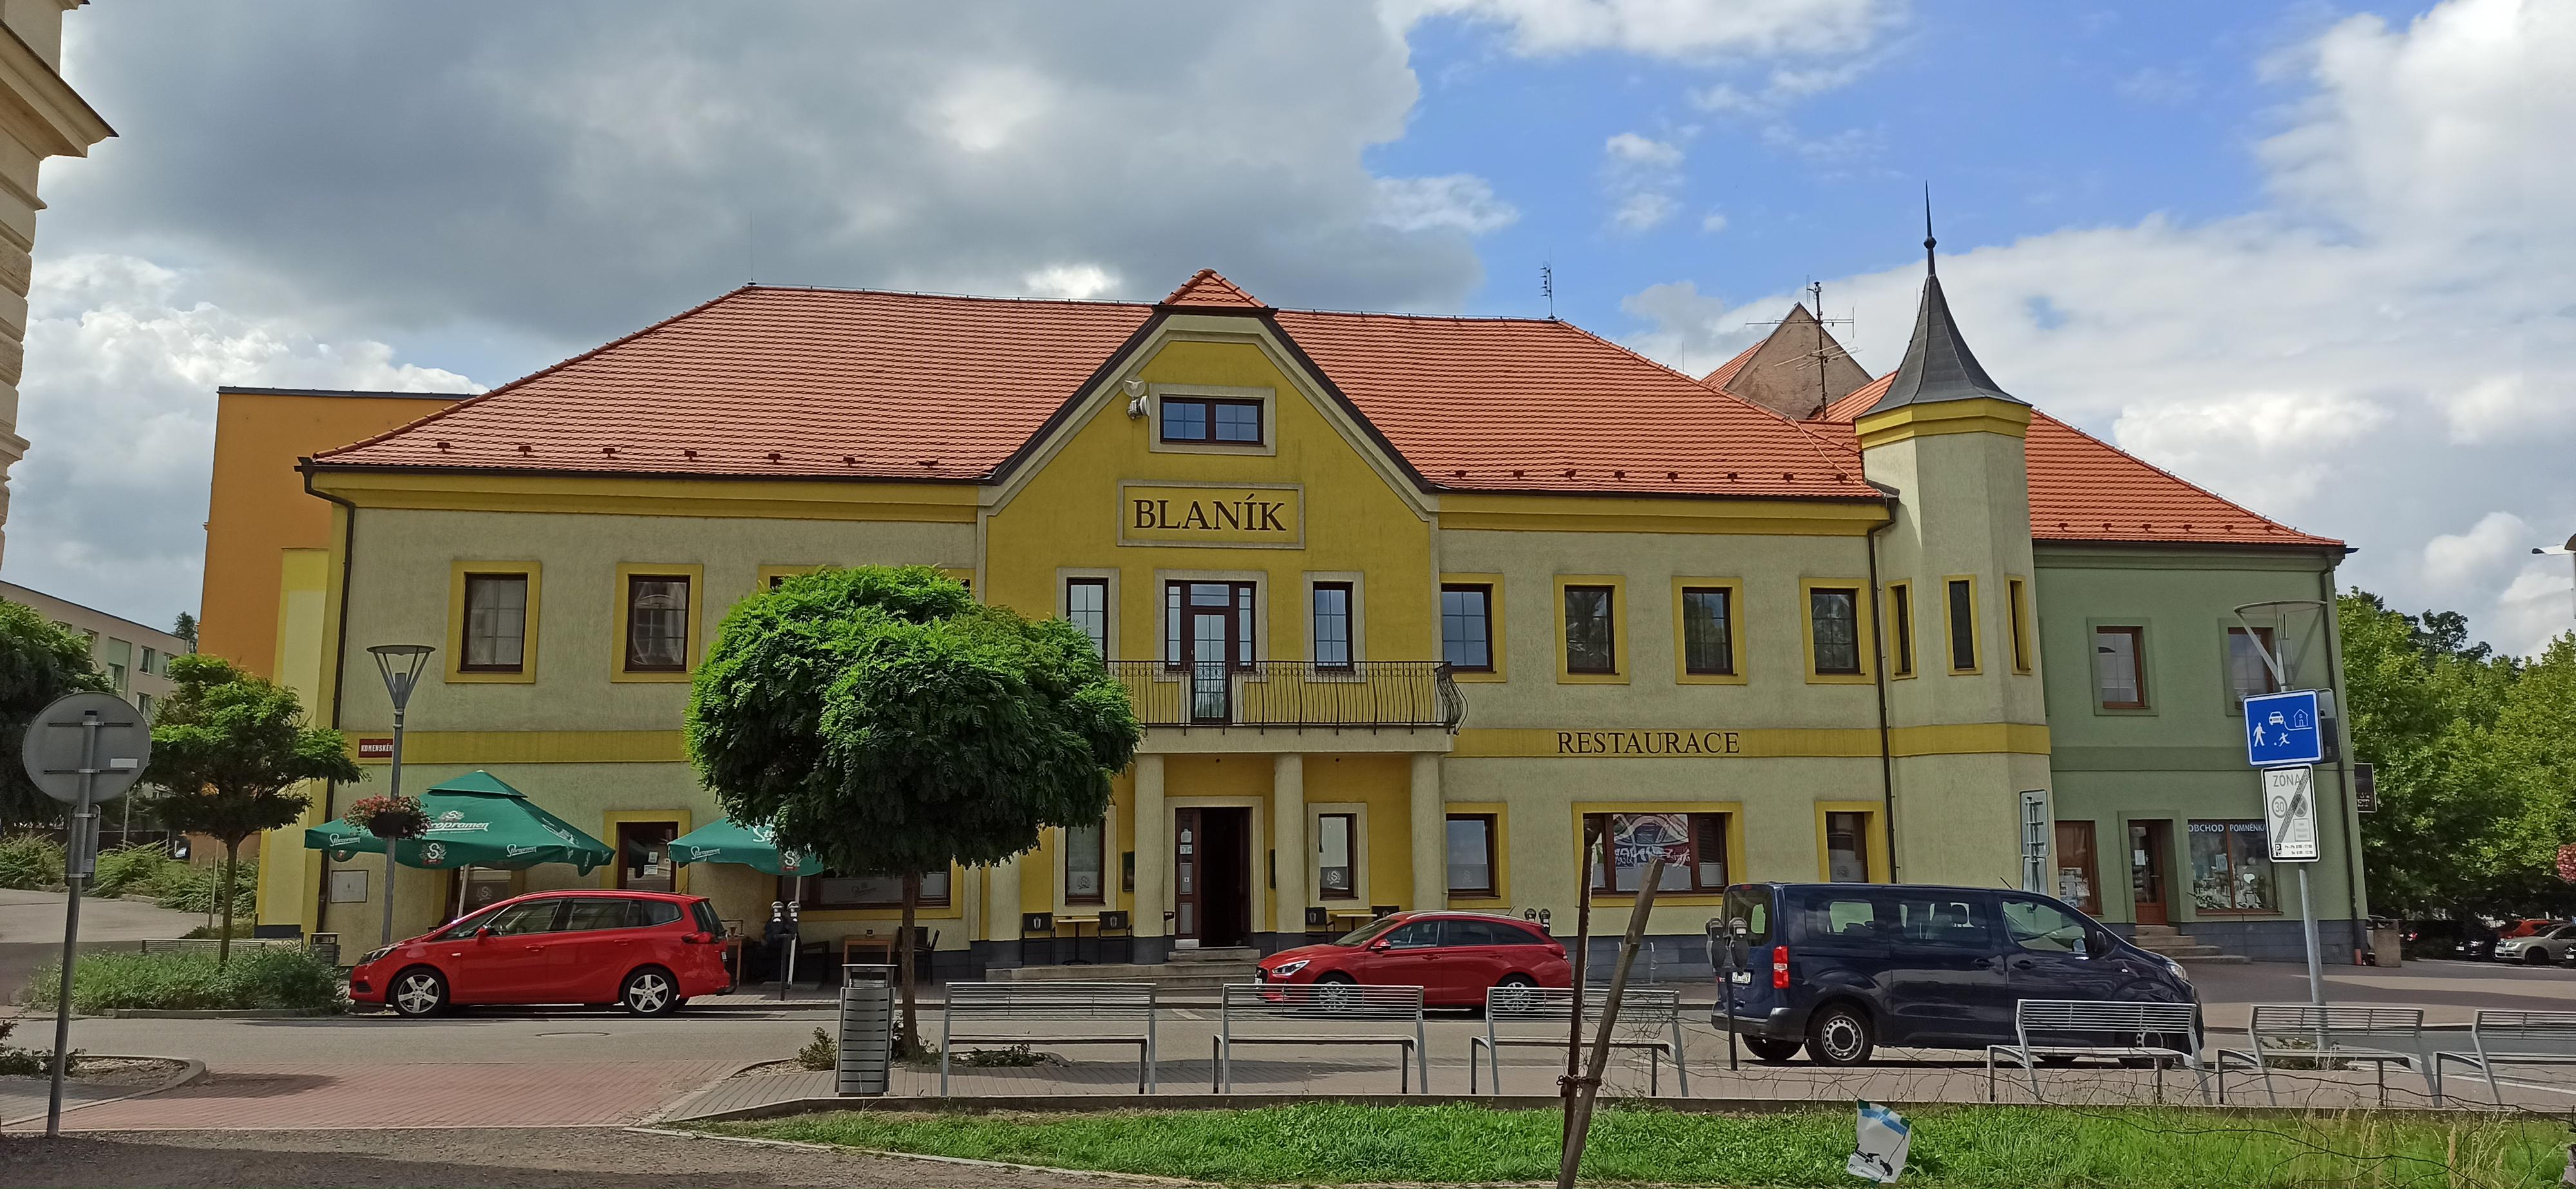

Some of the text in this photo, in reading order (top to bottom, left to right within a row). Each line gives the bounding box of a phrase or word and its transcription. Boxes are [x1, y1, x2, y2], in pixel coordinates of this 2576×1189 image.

[1133, 492, 1287, 531] BLANÍK
[361, 743, 393, 752] KOMENSKÉH
[1557, 731, 1740, 754] RESTAURACE
[2273, 772, 2302, 787] ZÓNA
[2275, 801, 2285, 812] 30
